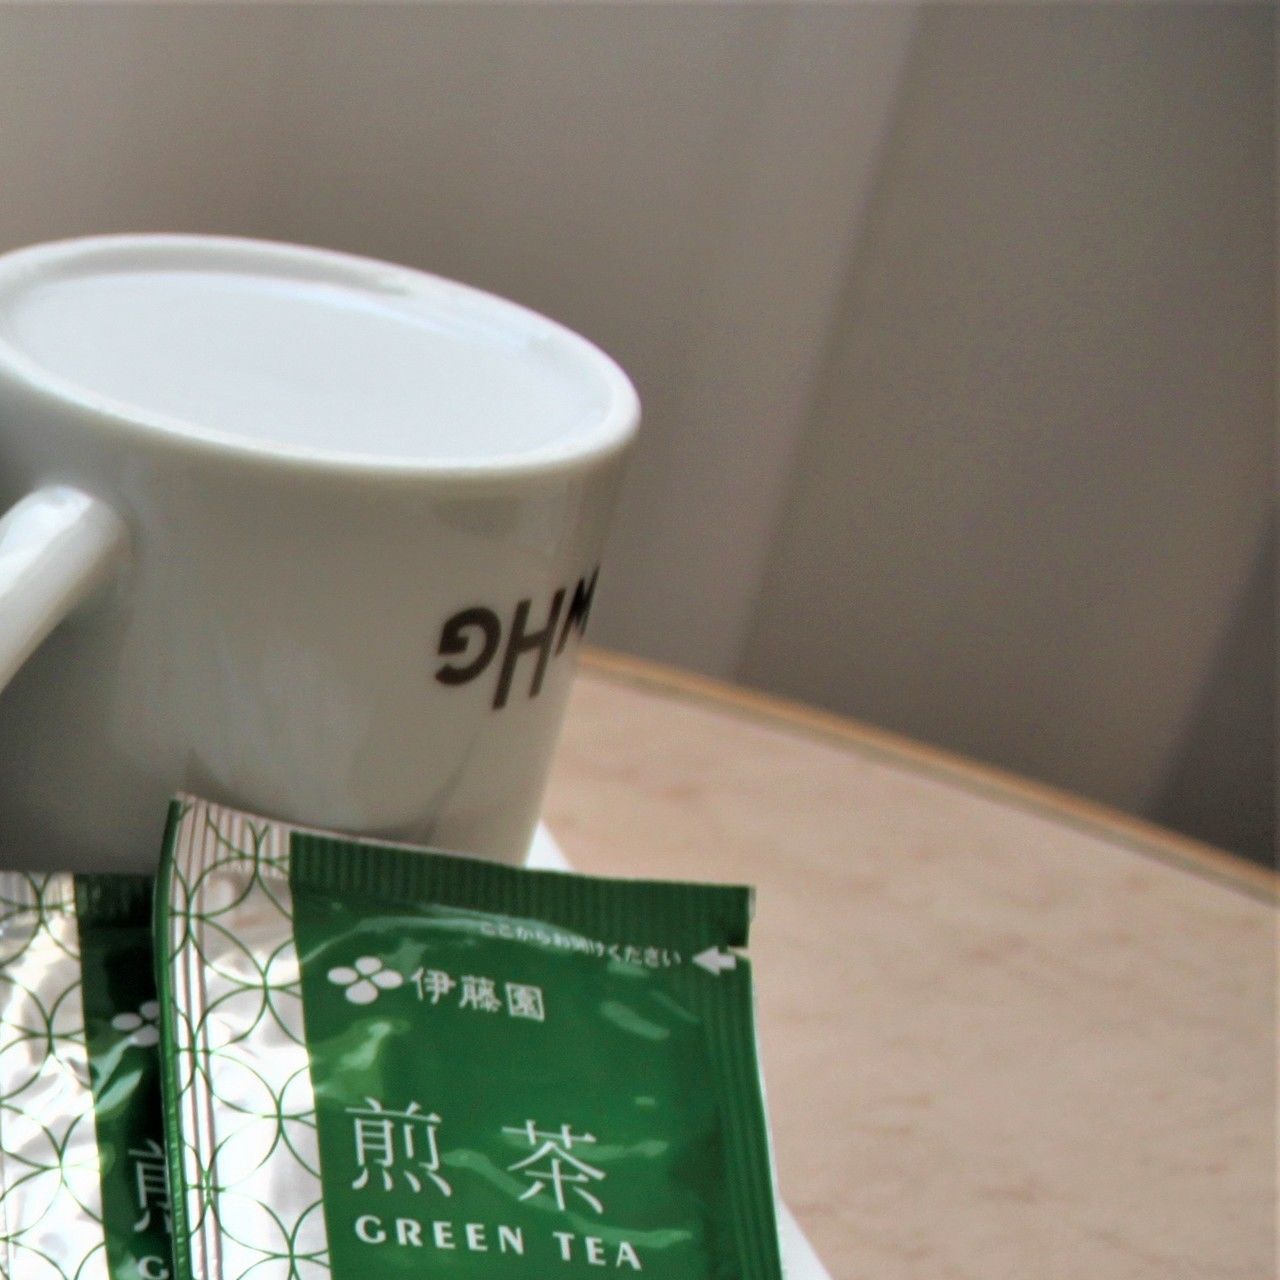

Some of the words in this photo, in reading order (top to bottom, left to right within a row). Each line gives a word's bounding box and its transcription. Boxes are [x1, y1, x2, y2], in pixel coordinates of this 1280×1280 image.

[410, 966, 545, 1022] 伊藤園
[355, 1214, 525, 1256] GREEN
[552, 1231, 642, 1272] TEA
